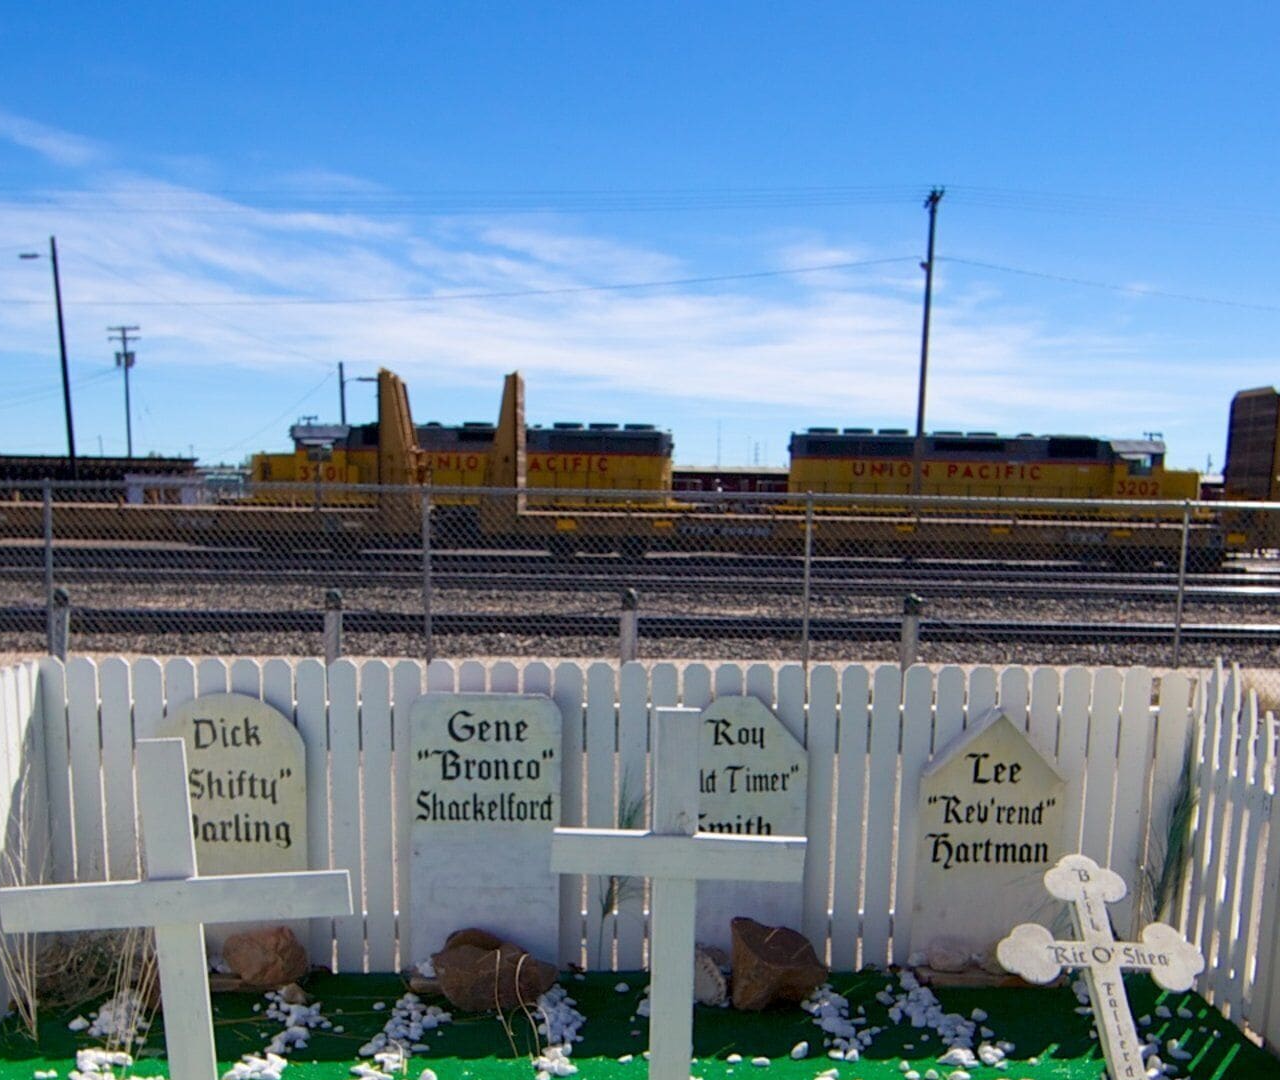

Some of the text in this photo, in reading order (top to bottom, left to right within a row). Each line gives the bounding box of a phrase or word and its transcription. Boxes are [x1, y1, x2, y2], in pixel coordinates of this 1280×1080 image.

[528, 457, 608, 472] ACIFIC
[852, 458, 1042, 480] UNION PACIFIC
[192, 716, 261, 749] Dick
[447, 710, 528, 742] Gene
[704, 718, 765, 749] Roy
[417, 748, 554, 780] "Bronco"
[965, 753, 1021, 784] Lee
[699, 768, 716, 793] ld
[416, 790, 553, 822] Shackelford
[925, 833, 1049, 869] Hartman
